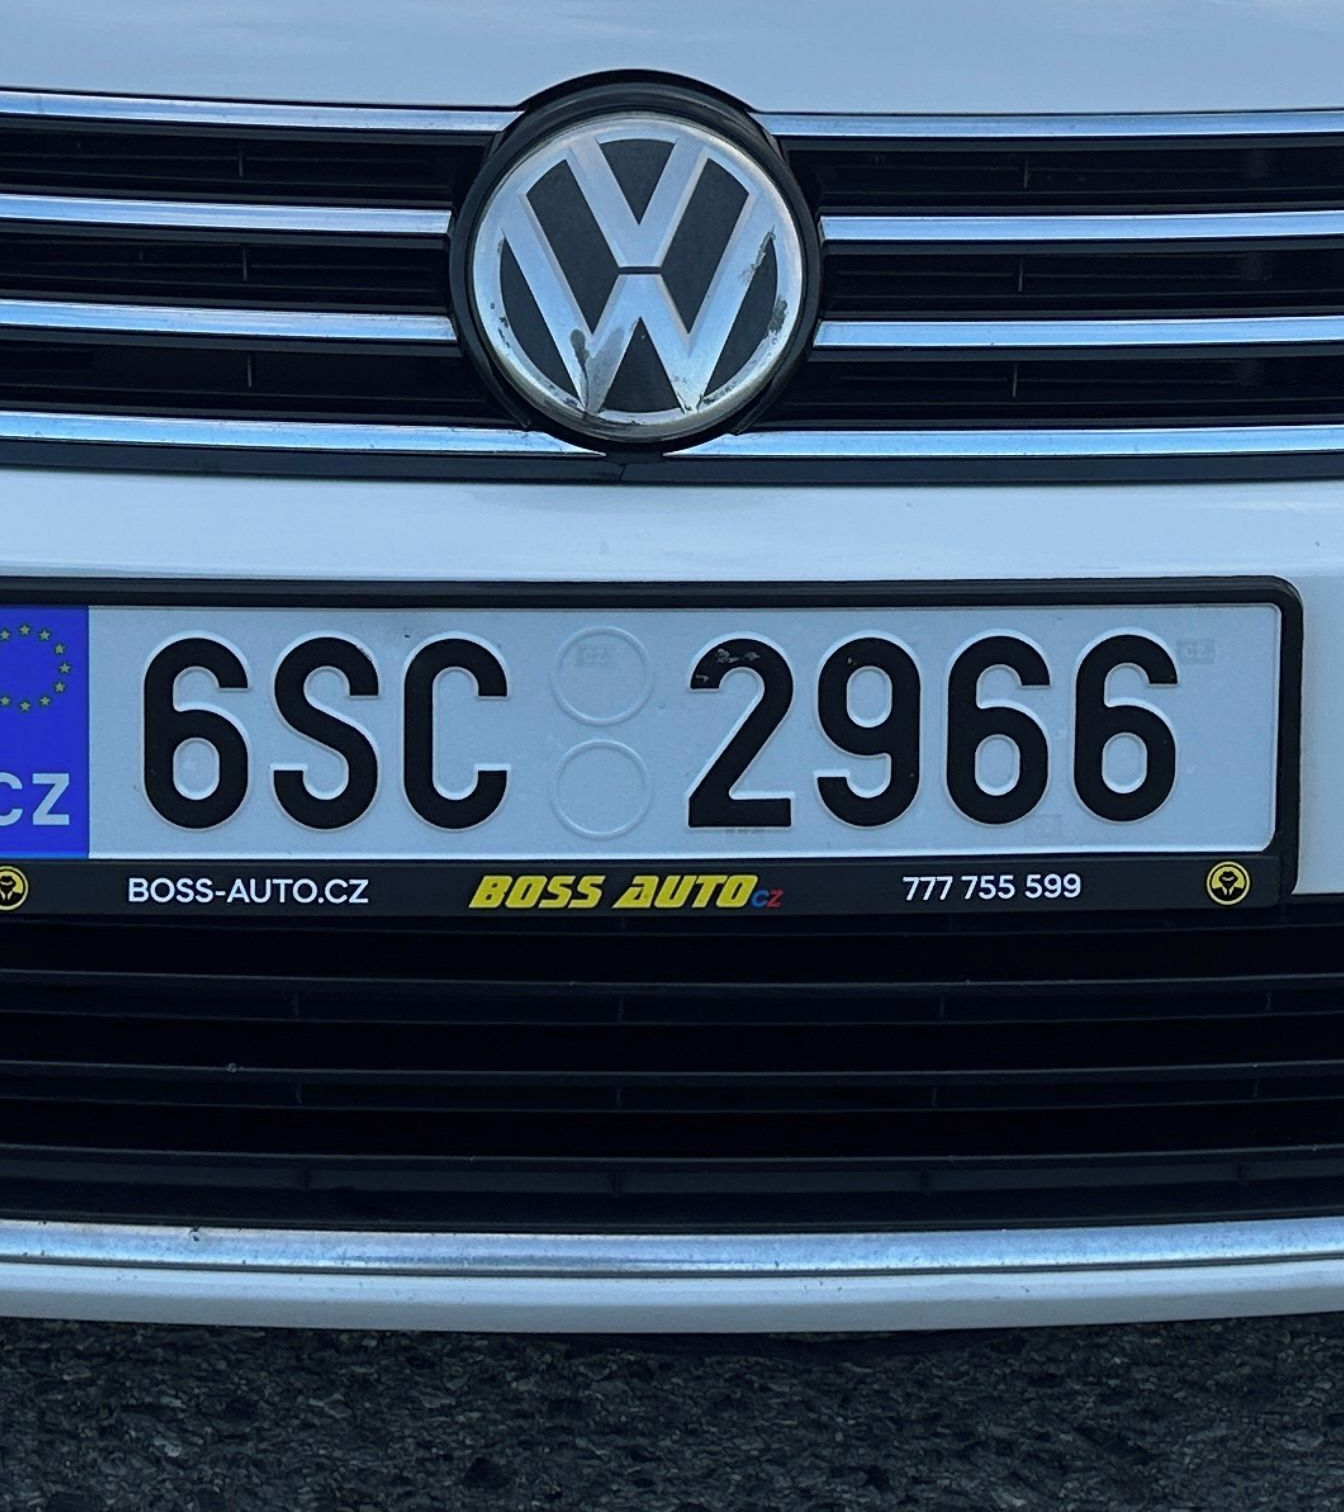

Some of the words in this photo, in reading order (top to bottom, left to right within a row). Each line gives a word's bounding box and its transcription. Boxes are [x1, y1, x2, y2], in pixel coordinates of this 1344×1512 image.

[142, 636, 509, 830] 6SC
[687, 634, 1178, 828] 2966
[129, 878, 369, 905] BOSS-AUTO.CZ
[468, 875, 605, 909] BOSS
[903, 876, 953, 901] 777
[961, 875, 1016, 900] 755
[1024, 873, 1081, 899] 599
